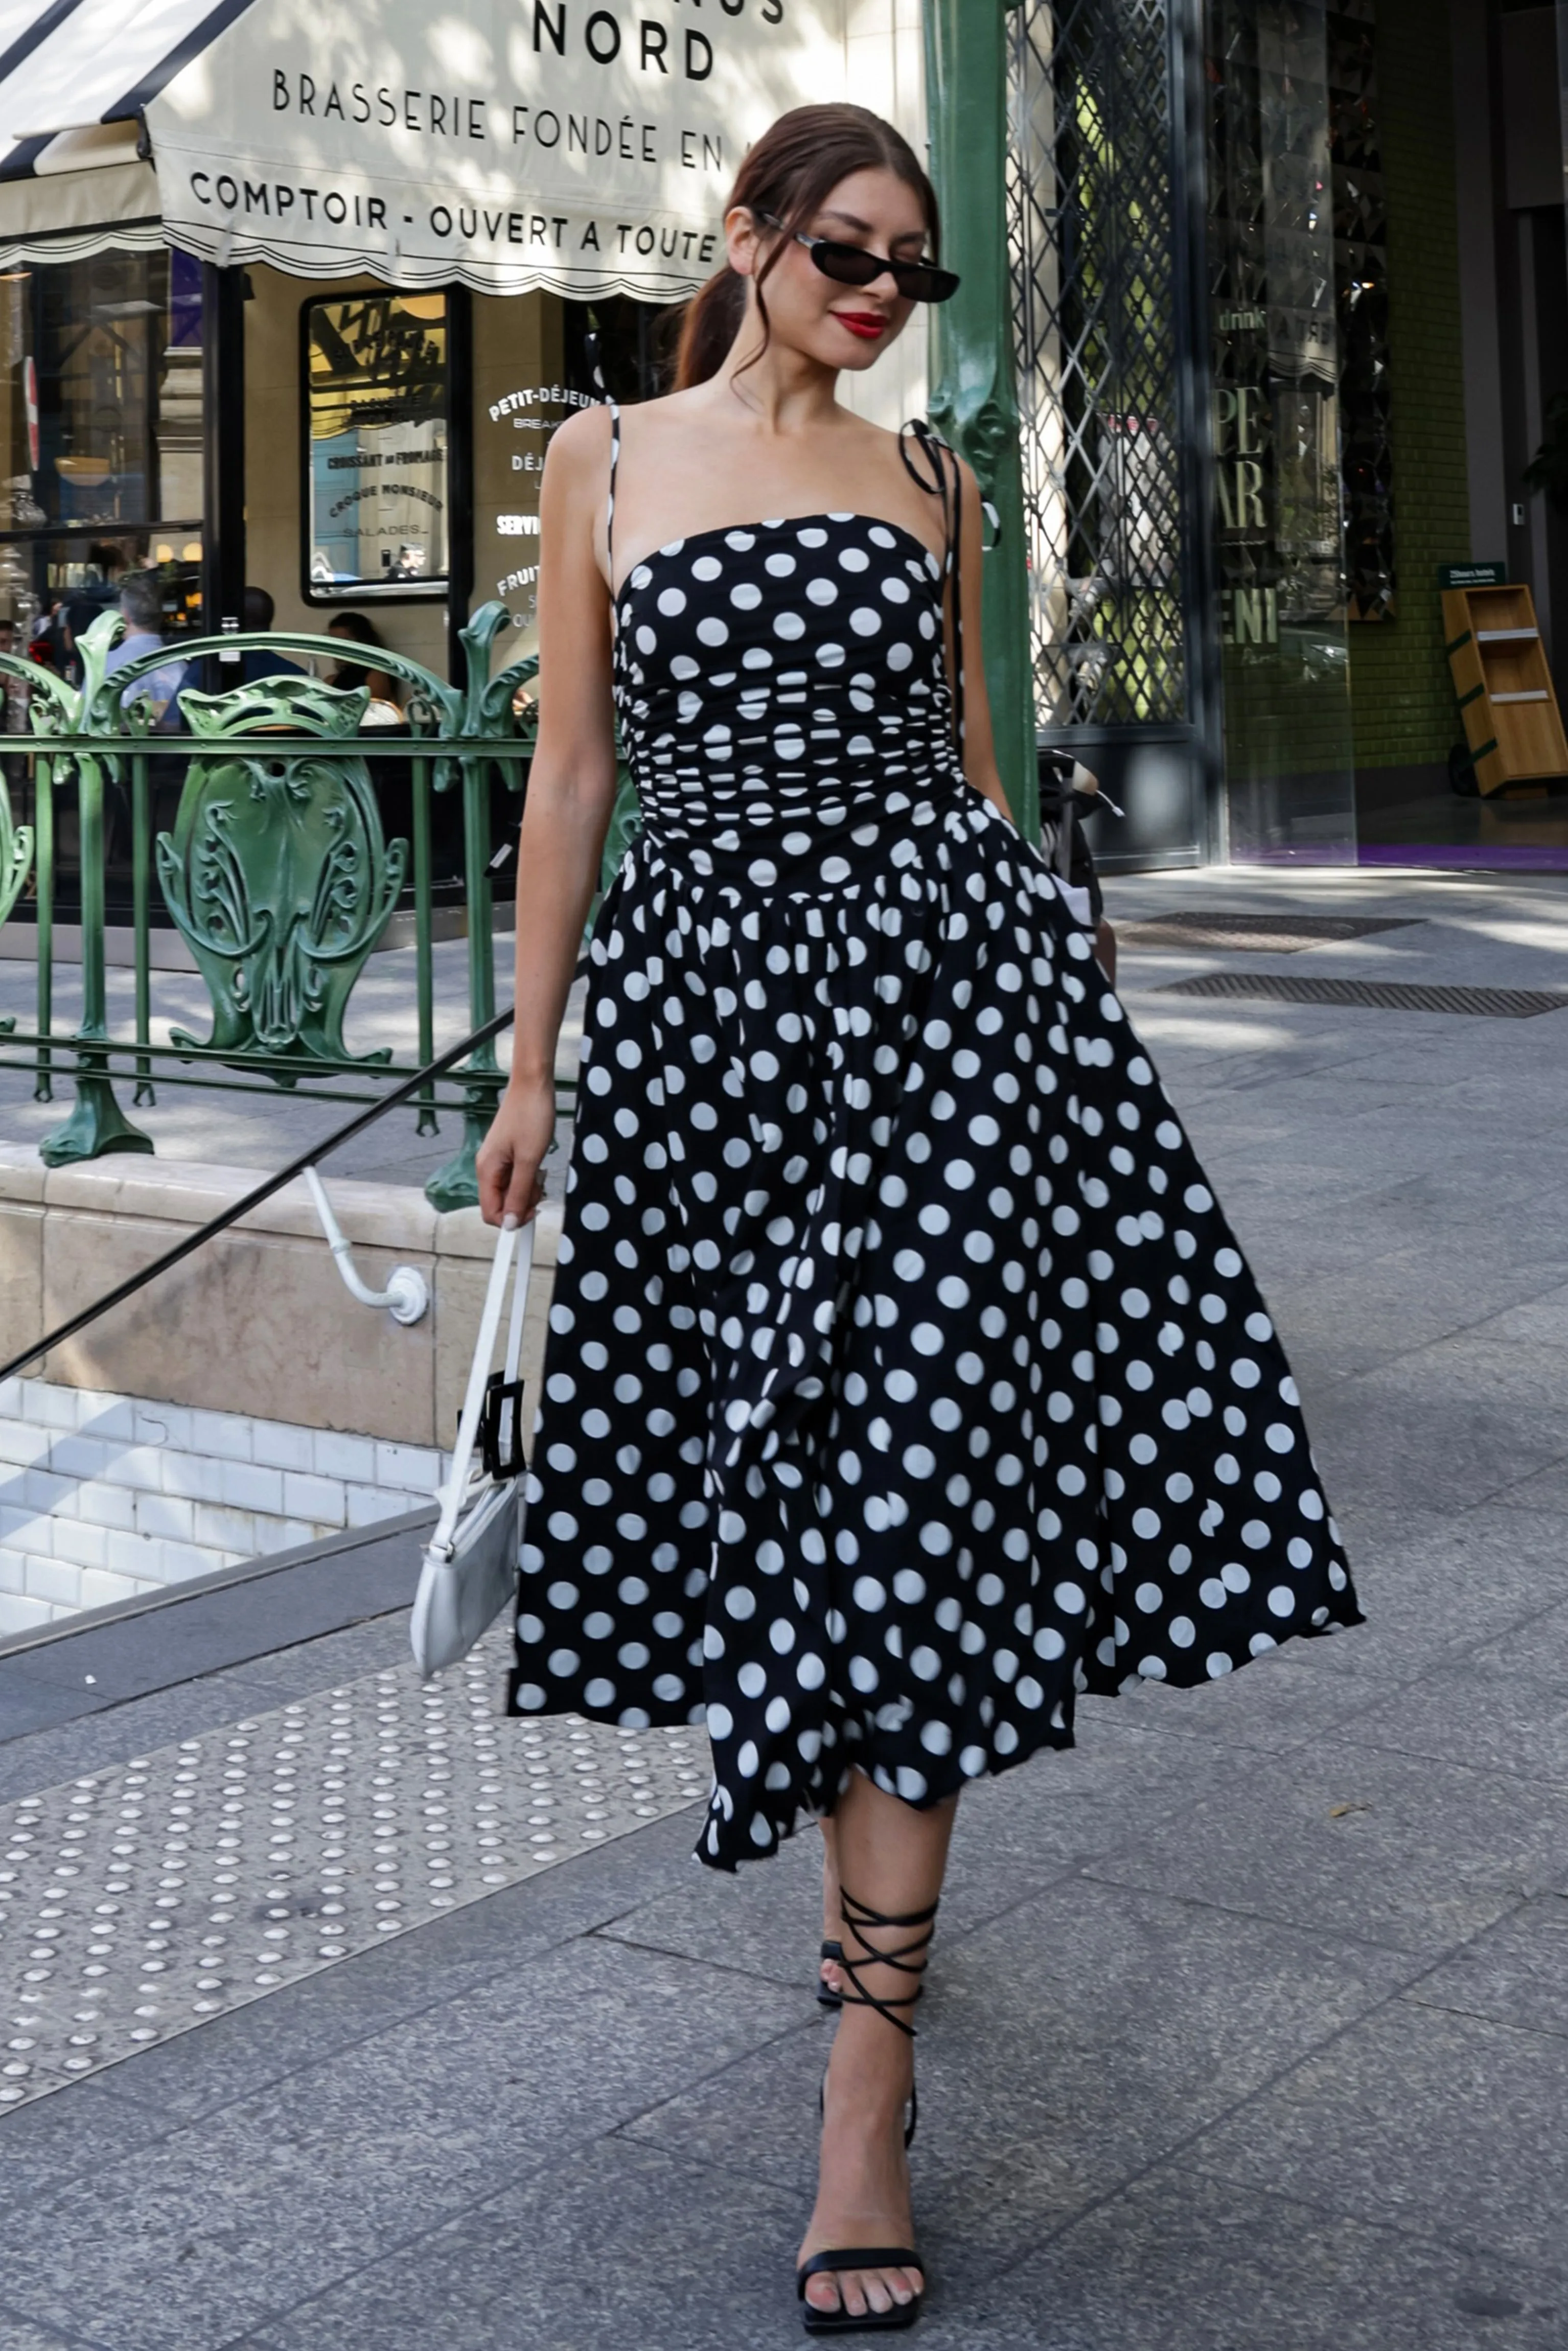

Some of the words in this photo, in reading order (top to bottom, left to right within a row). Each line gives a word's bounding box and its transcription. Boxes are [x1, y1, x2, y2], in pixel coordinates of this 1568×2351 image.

[533, 0, 713, 81] NORD
[273, 68, 486, 140] BRASSERIE
[513, 105, 658, 163] FONDÉE
[681, 131, 723, 172] EN
[190, 172, 387, 231] COMPTOIR
[430, 206, 568, 247] OUVERT
[581, 221, 601, 251] A
[616, 224, 718, 263] TOUTE
[329, 485, 378, 518] CROQUE
[381, 483, 443, 513] MONSIEUR
[496, 515, 540, 535] SERVI
